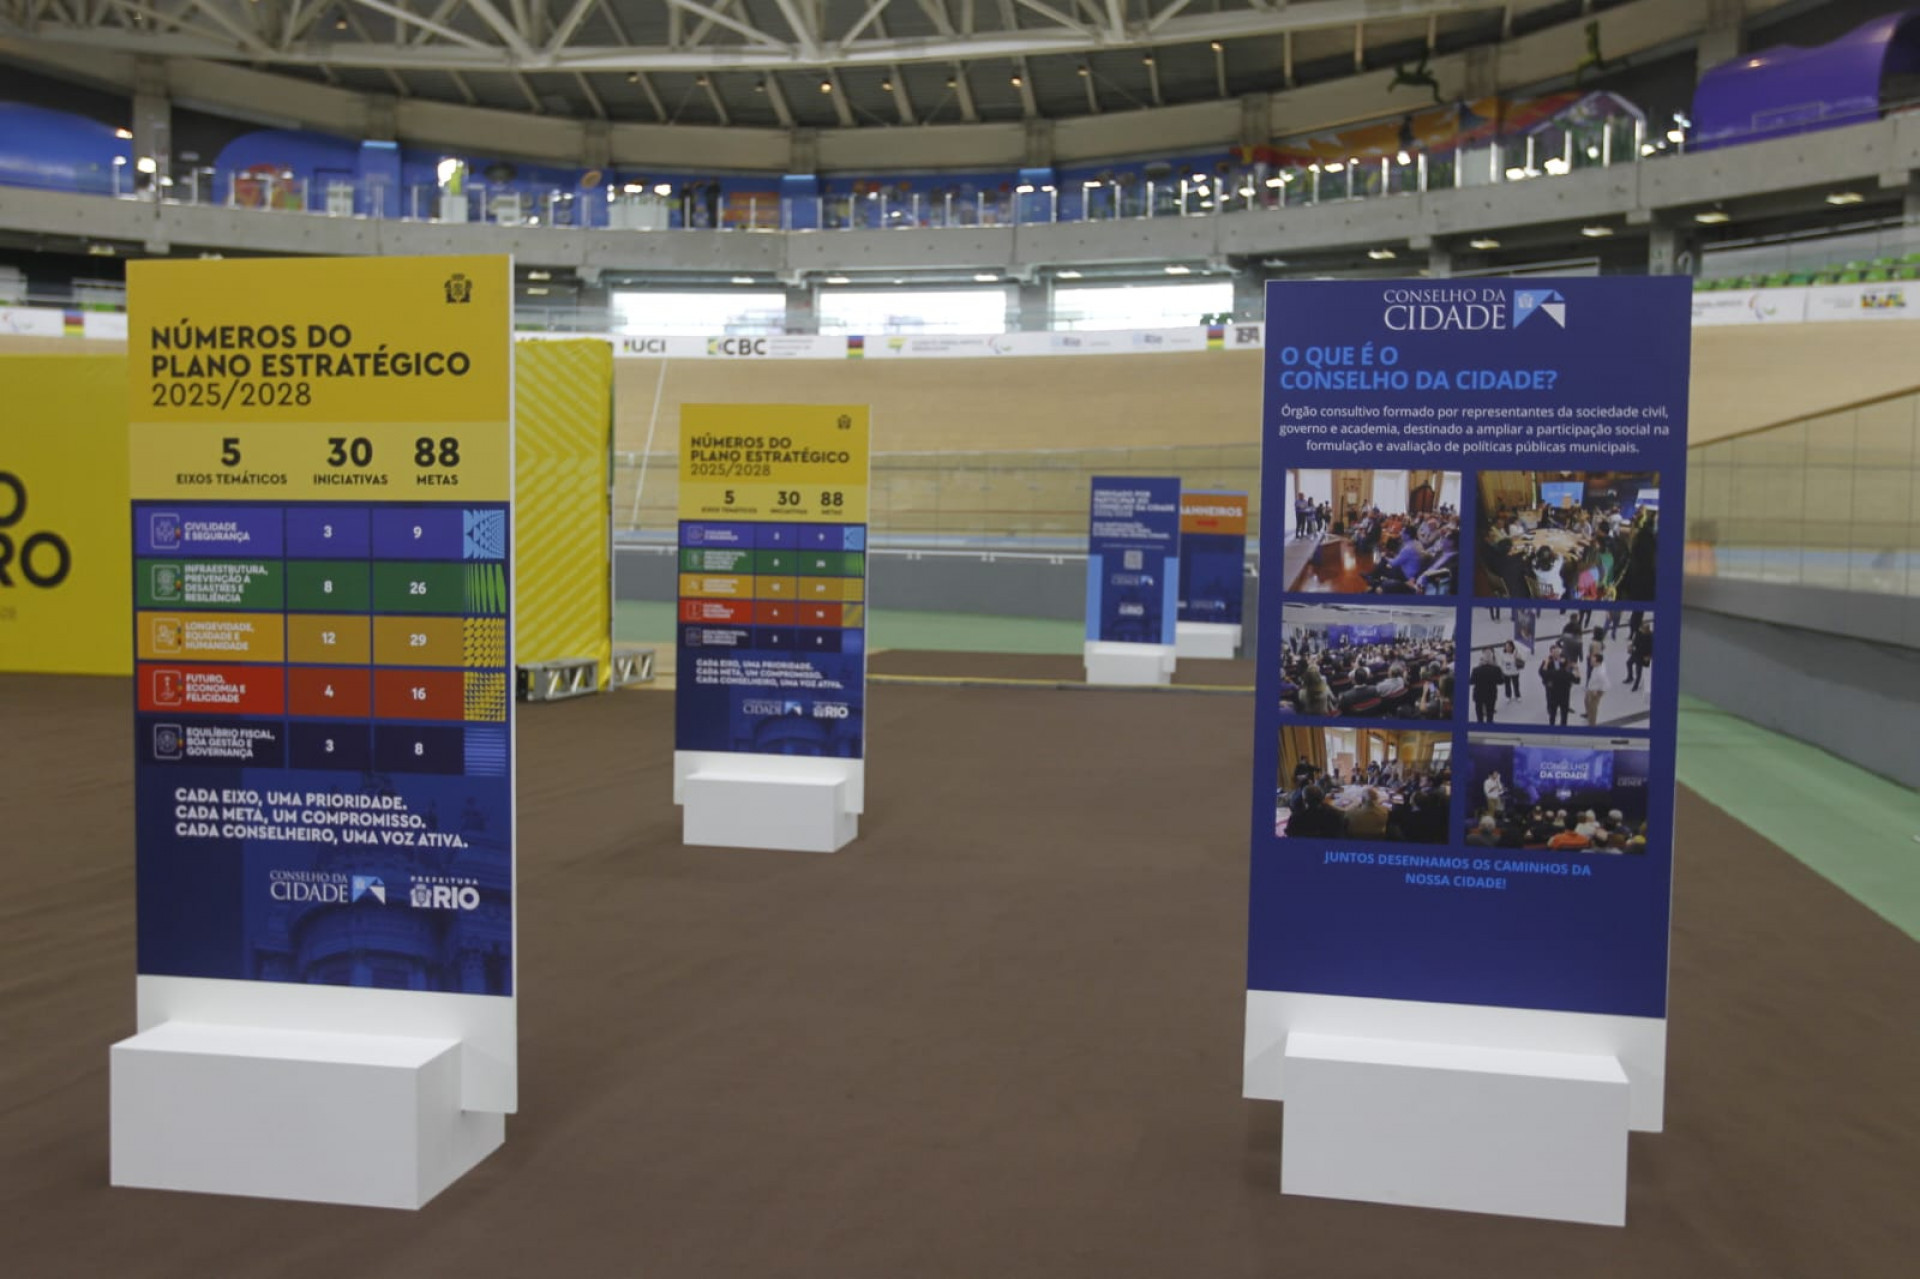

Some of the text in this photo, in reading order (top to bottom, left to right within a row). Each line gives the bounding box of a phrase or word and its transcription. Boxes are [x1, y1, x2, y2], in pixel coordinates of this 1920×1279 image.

[1383, 289, 1506, 303] CONSELHO DA
[1384, 304, 1506, 331] CIDADE
[152, 318, 352, 349] NÚMEROS DO
[631, 339, 666, 353] UCI
[724, 339, 767, 355] CBC
[152, 344, 470, 378] PLANO ESTRATÉGICO
[1281, 341, 1398, 369] O QUE É O
[1280, 369, 1558, 390] CONSELHO DA CIDADE?
[152, 379, 312, 410] 2025/2028
[1281, 403, 1669, 420] Órgão consultivo formado por representantes da sociedade civil,
[1279, 423, 1669, 438] governo e academia, destinado a ampliar a participação social na
[690, 432, 792, 448] NÚMEROS DO
[221, 437, 242, 467] 5
[327, 437, 373, 467] 30
[414, 437, 460, 467] 88
[690, 446, 850, 463] PLANO ESTRATÉGICO
[1306, 440, 1640, 456] formulação e avaliação de políticas públicas municipais.
[691, 463, 771, 477] 2025/2028
[176, 471, 287, 485] EIXOS TEMÁTICOS
[313, 474, 388, 485] INICIATIVAS
[417, 474, 459, 486] METAS
[724, 490, 735, 505] 5
[777, 491, 801, 506] 30
[820, 491, 844, 506] 88
[1180, 505, 1243, 517] ANHEIROS
[184, 522, 238, 531] CIVILIDADE
[323, 524, 332, 538] 3
[413, 526, 422, 539] 9
[185, 531, 251, 543] E SEGURANÇA
[324, 580, 333, 593] 8
[410, 582, 427, 595] 26
[321, 632, 336, 645] 12
[410, 634, 427, 647] 29
[186, 674, 225, 684] FUTURO,
[186, 683, 238, 693] ECONOMIA
[324, 685, 334, 698] 4
[411, 687, 427, 700] 16
[186, 693, 240, 703] FELICIDADE
[825, 705, 849, 719] RIO
[186, 726, 275, 740] EQUILÍBRIO FISCAL,
[186, 737, 207, 747] BOA
[209, 736, 245, 748] GESTÃO
[325, 739, 334, 752] 3
[414, 742, 424, 755] 8
[186, 747, 253, 760] GOVERNANÇA
[1540, 771, 1589, 780] DA CIDADE
[175, 787, 408, 811] CADA EIXO, UMA PRIORIDADE.
[175, 805, 426, 829] CADA META, UM COMPROMISSO.
[175, 822, 469, 848] CADA CONSELHEIRO, UMA VOZ ATIVA.
[1322, 851, 1591, 876] JUNTOS DESENHAMOS OS CAMINHOS DA
[270, 870, 348, 883] CONSELHO DA
[410, 875, 479, 886] PREFEITURA
[1405, 873, 1506, 889] NOSSA CIDADE!
[270, 881, 348, 903] CIDADE
[433, 885, 480, 910] RIO
